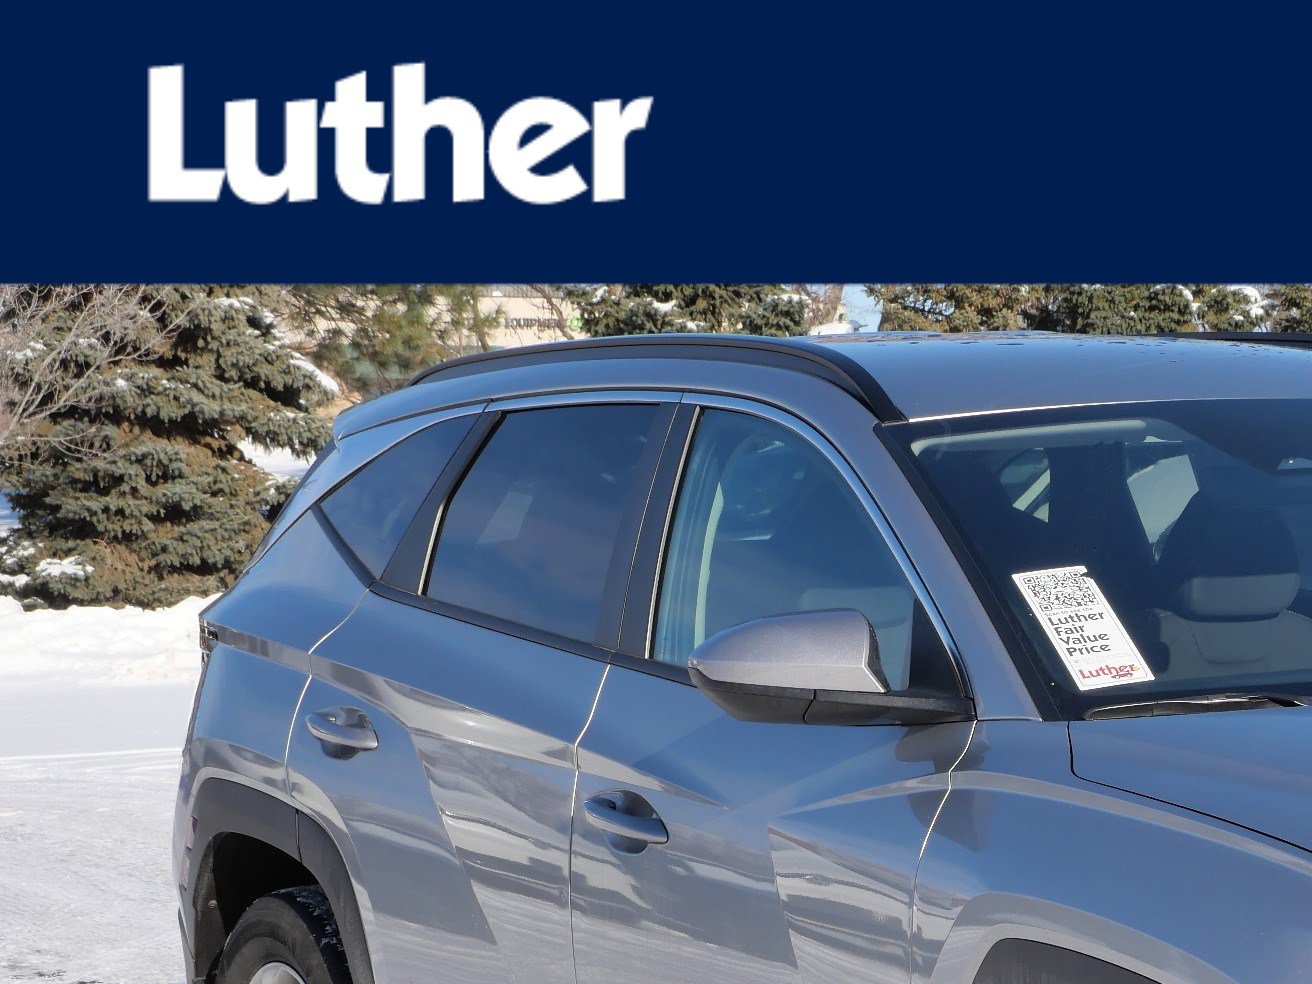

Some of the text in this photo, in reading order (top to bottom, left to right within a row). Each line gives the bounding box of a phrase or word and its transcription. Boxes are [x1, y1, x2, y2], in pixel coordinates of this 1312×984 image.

[1048, 611, 1105, 626] Luther
[1053, 623, 1085, 637] Fair
[1059, 633, 1110, 646] Value
[1065, 644, 1111, 657] Price
[1078, 664, 1136, 679] Luther
